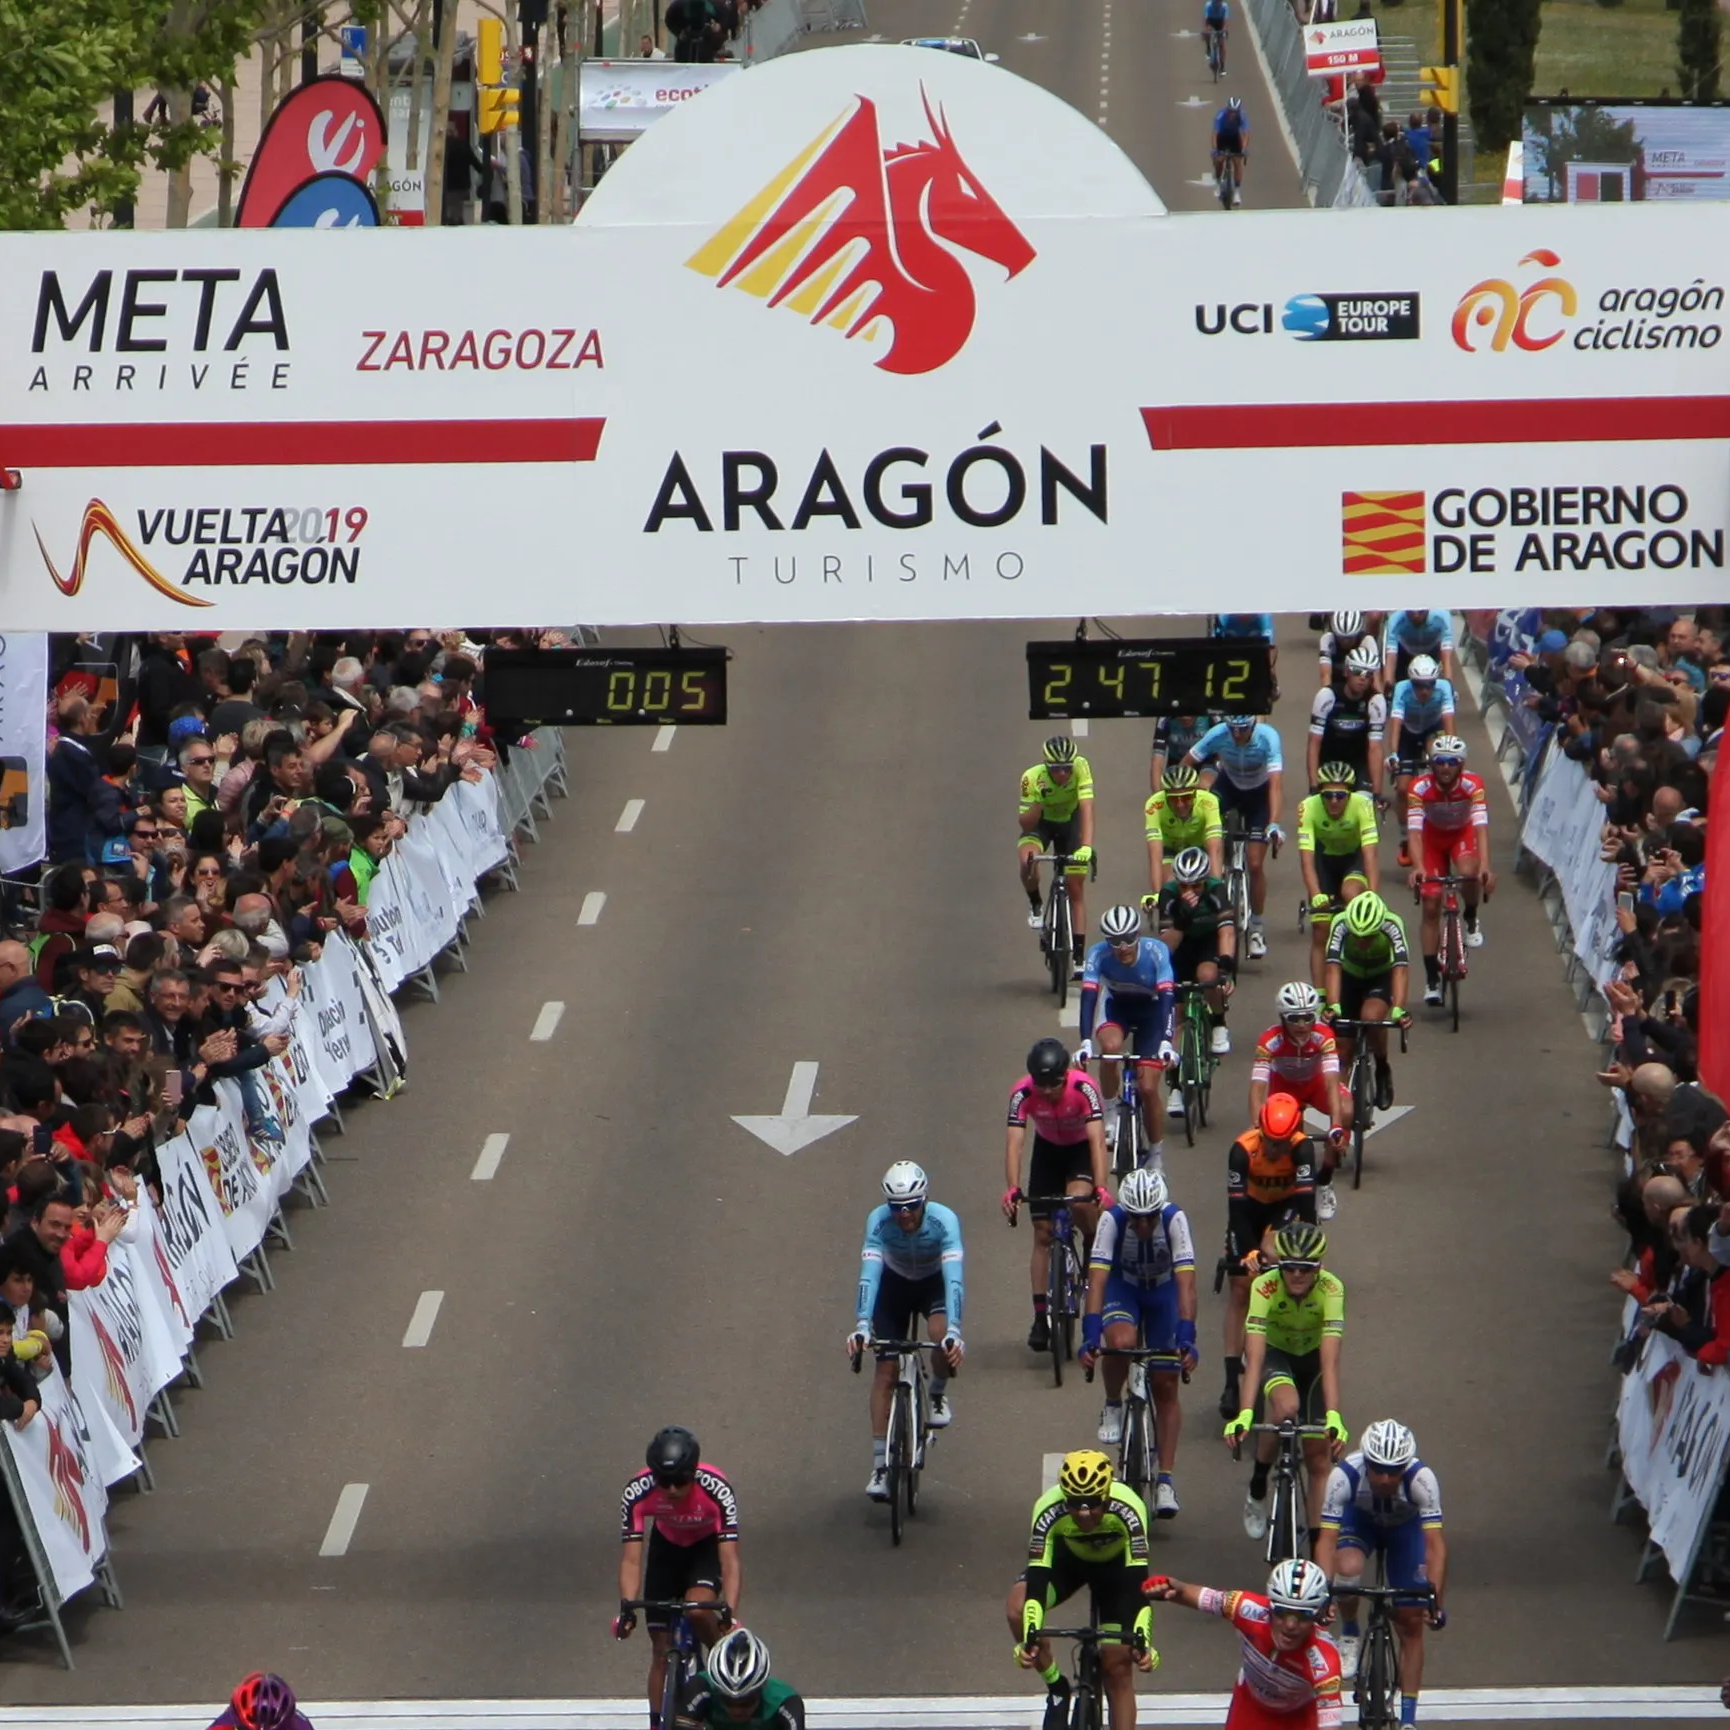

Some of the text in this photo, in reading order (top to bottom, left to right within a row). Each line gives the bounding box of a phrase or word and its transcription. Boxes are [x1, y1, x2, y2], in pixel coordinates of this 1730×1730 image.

[1330, 26, 1374, 39] ARAGÓN
[30, 267, 291, 353] META
[1195, 303, 1274, 335] UCI
[1336, 298, 1413, 320] EUROPE
[1338, 313, 1391, 334] TOUR
[355, 328, 605, 372] ZARAGOZA
[1573, 319, 1722, 351] ciclismo
[28, 358, 293, 392] ARRIVÉE
[643, 419, 1109, 534] ARAGÓN
[1432, 483, 1689, 529] GOBIERNO
[182, 537, 360, 586] ARAGÓN
[729, 549, 1027, 586] TURISMO
[1432, 528, 1725, 573] DE ARAGON
[695, 1471, 738, 1527] POSTOBON
[1108, 1500, 1139, 1532] EFAPEL
